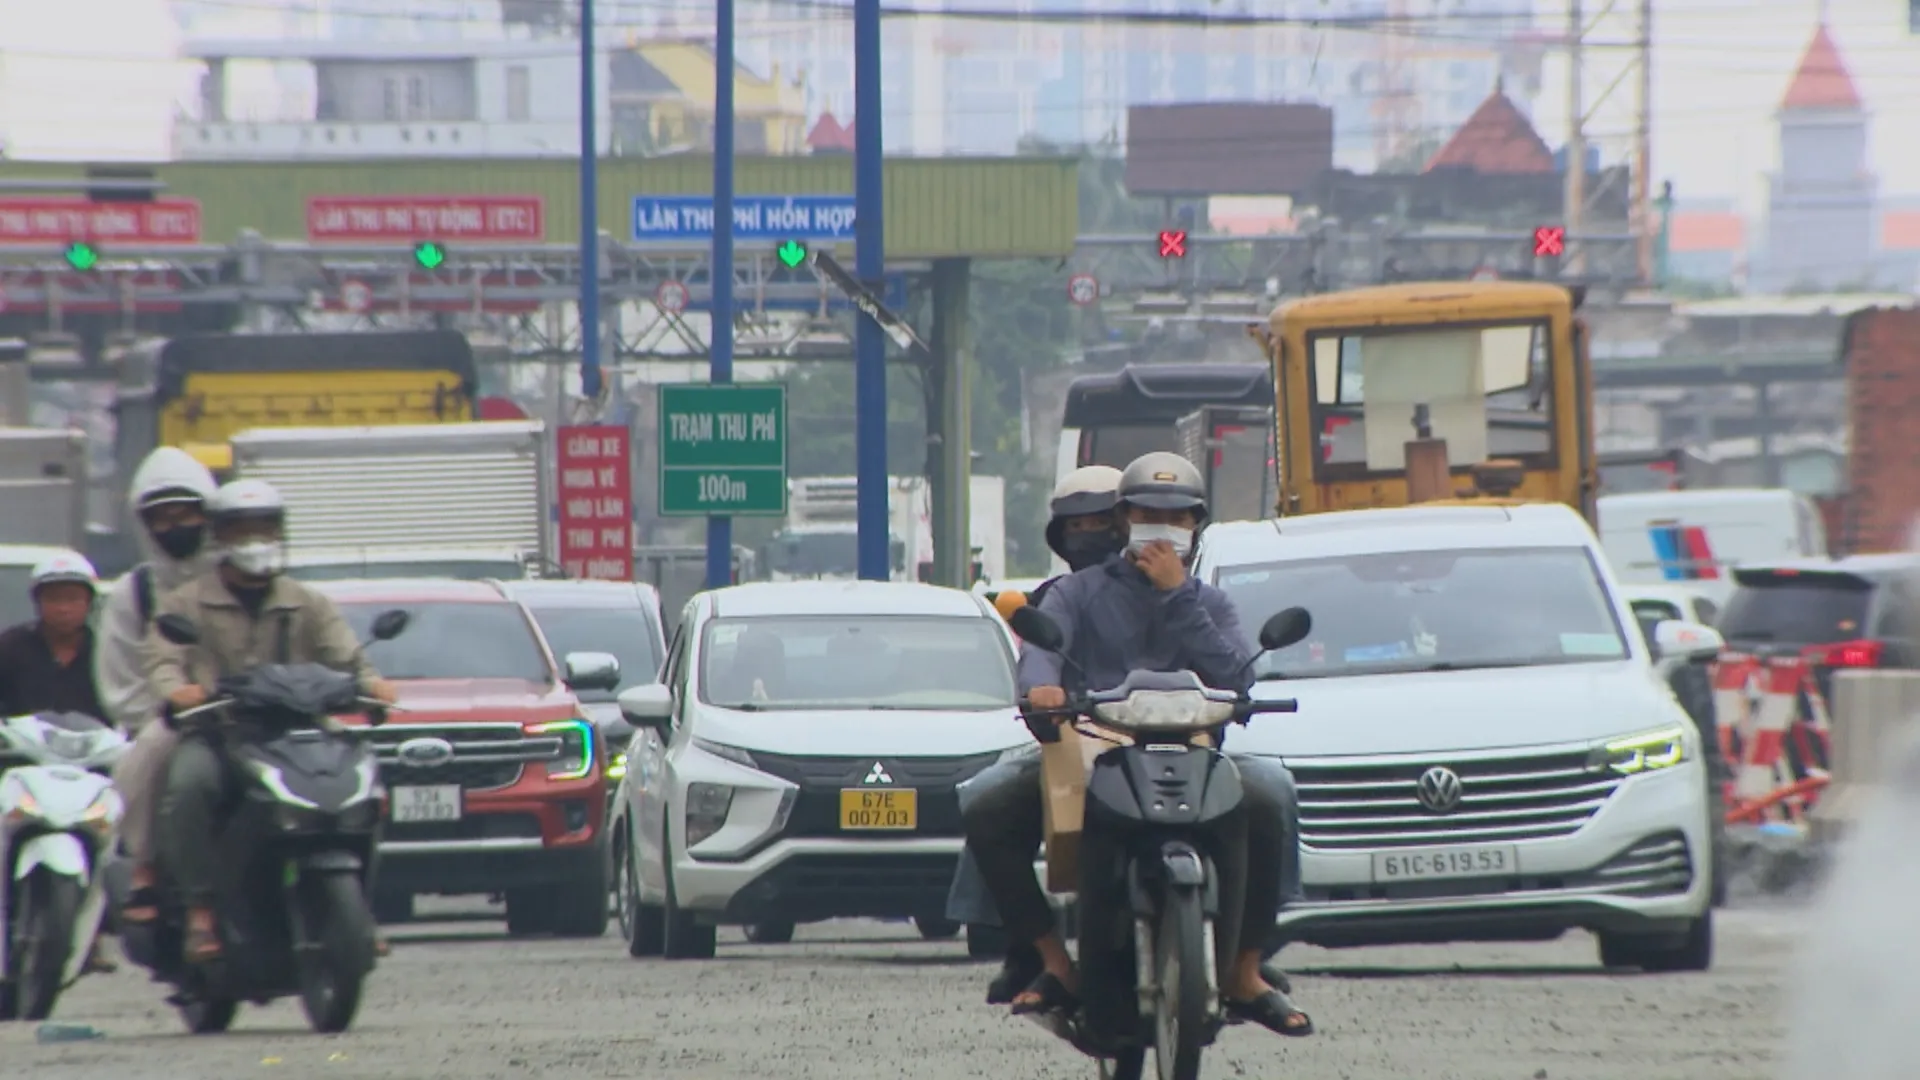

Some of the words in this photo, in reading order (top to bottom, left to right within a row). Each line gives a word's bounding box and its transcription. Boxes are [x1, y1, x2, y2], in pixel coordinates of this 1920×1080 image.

[638, 202, 678, 231] LÀN
[670, 412, 713, 447] TRẠM
[718, 413, 747, 441] THU
[752, 407, 776, 441] PHÍ
[602, 437, 621, 457] XE
[698, 474, 747, 502] 100m
[595, 497, 624, 518] LÀN
[567, 528, 594, 548] THU
[601, 526, 625, 548] PHÍ
[862, 792, 895, 808] 67E
[849, 810, 908, 826] 007.03
[1385, 850, 1503, 876] 61C-619.53
